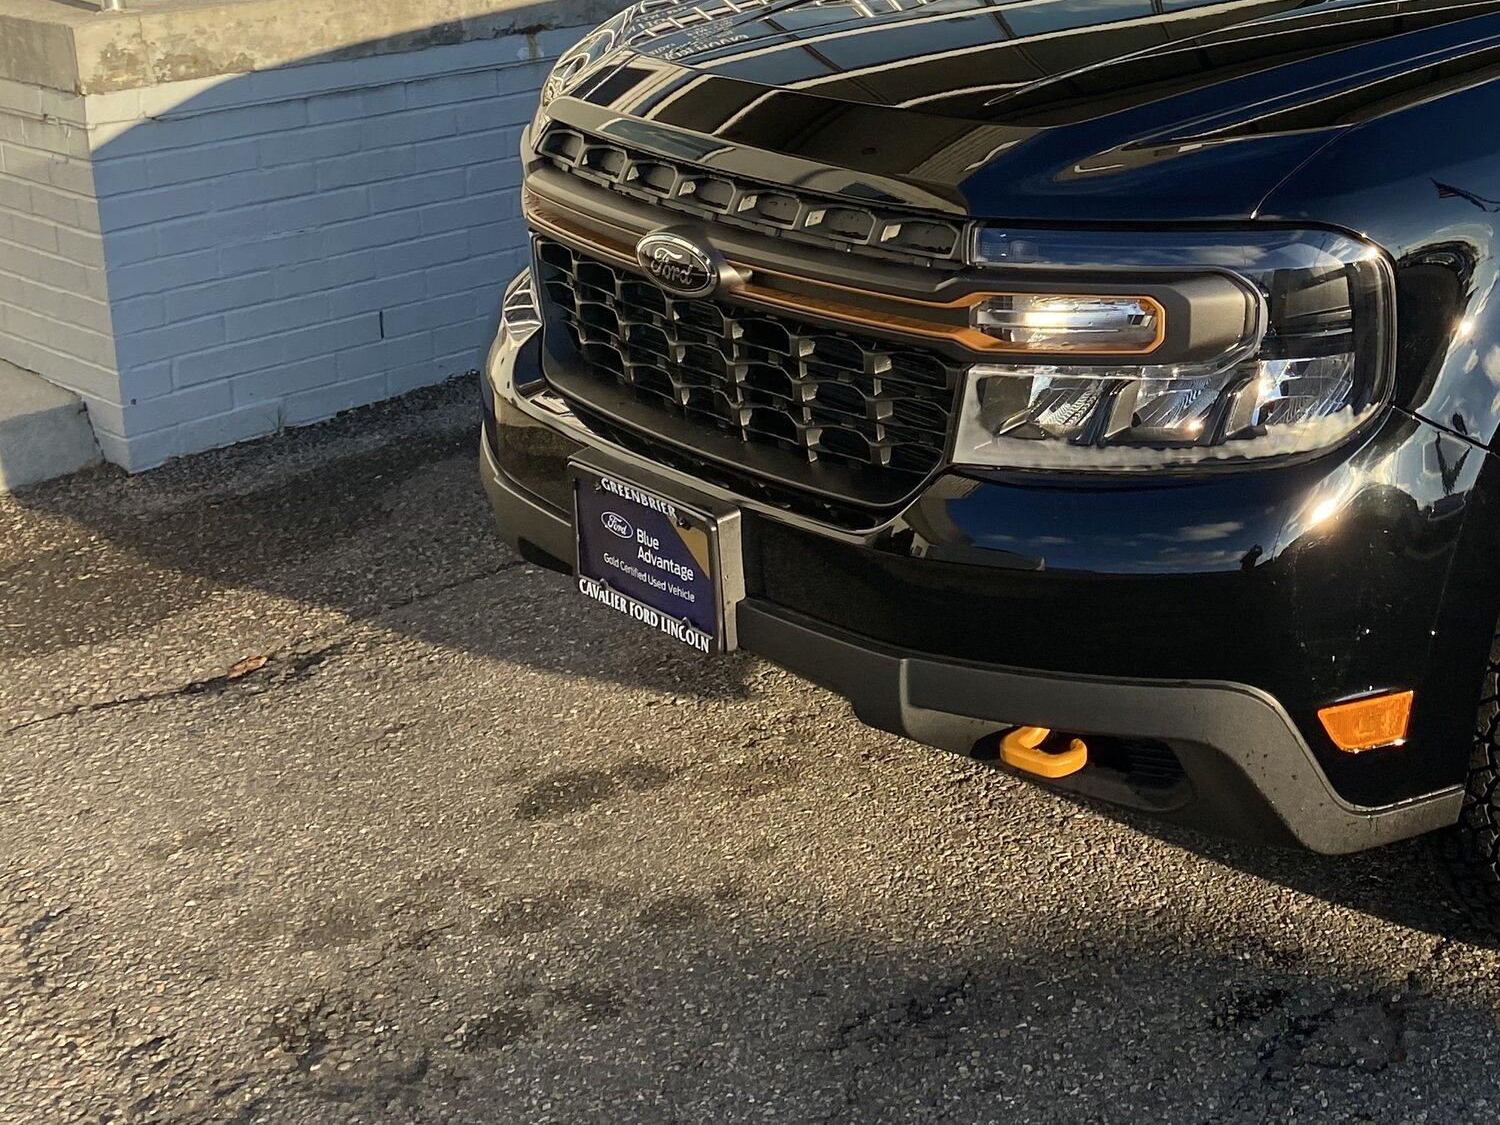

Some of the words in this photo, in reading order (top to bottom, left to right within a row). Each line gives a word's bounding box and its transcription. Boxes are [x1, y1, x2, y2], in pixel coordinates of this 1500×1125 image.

[650, 246, 694, 285] Ford
[601, 477, 678, 519] GREENBRIER
[607, 514, 628, 535] Ford
[636, 528, 660, 550] Blue
[603, 552, 620, 568] Gold
[619, 560, 647, 582] Certified
[647, 573, 667, 591] Used
[667, 582, 695, 602] Vehicle
[637, 546, 694, 581] Advantage
[579, 578, 628, 614] CAVALIER
[629, 602, 659, 627] FORD
[660, 616, 710, 654] LINCOLN
